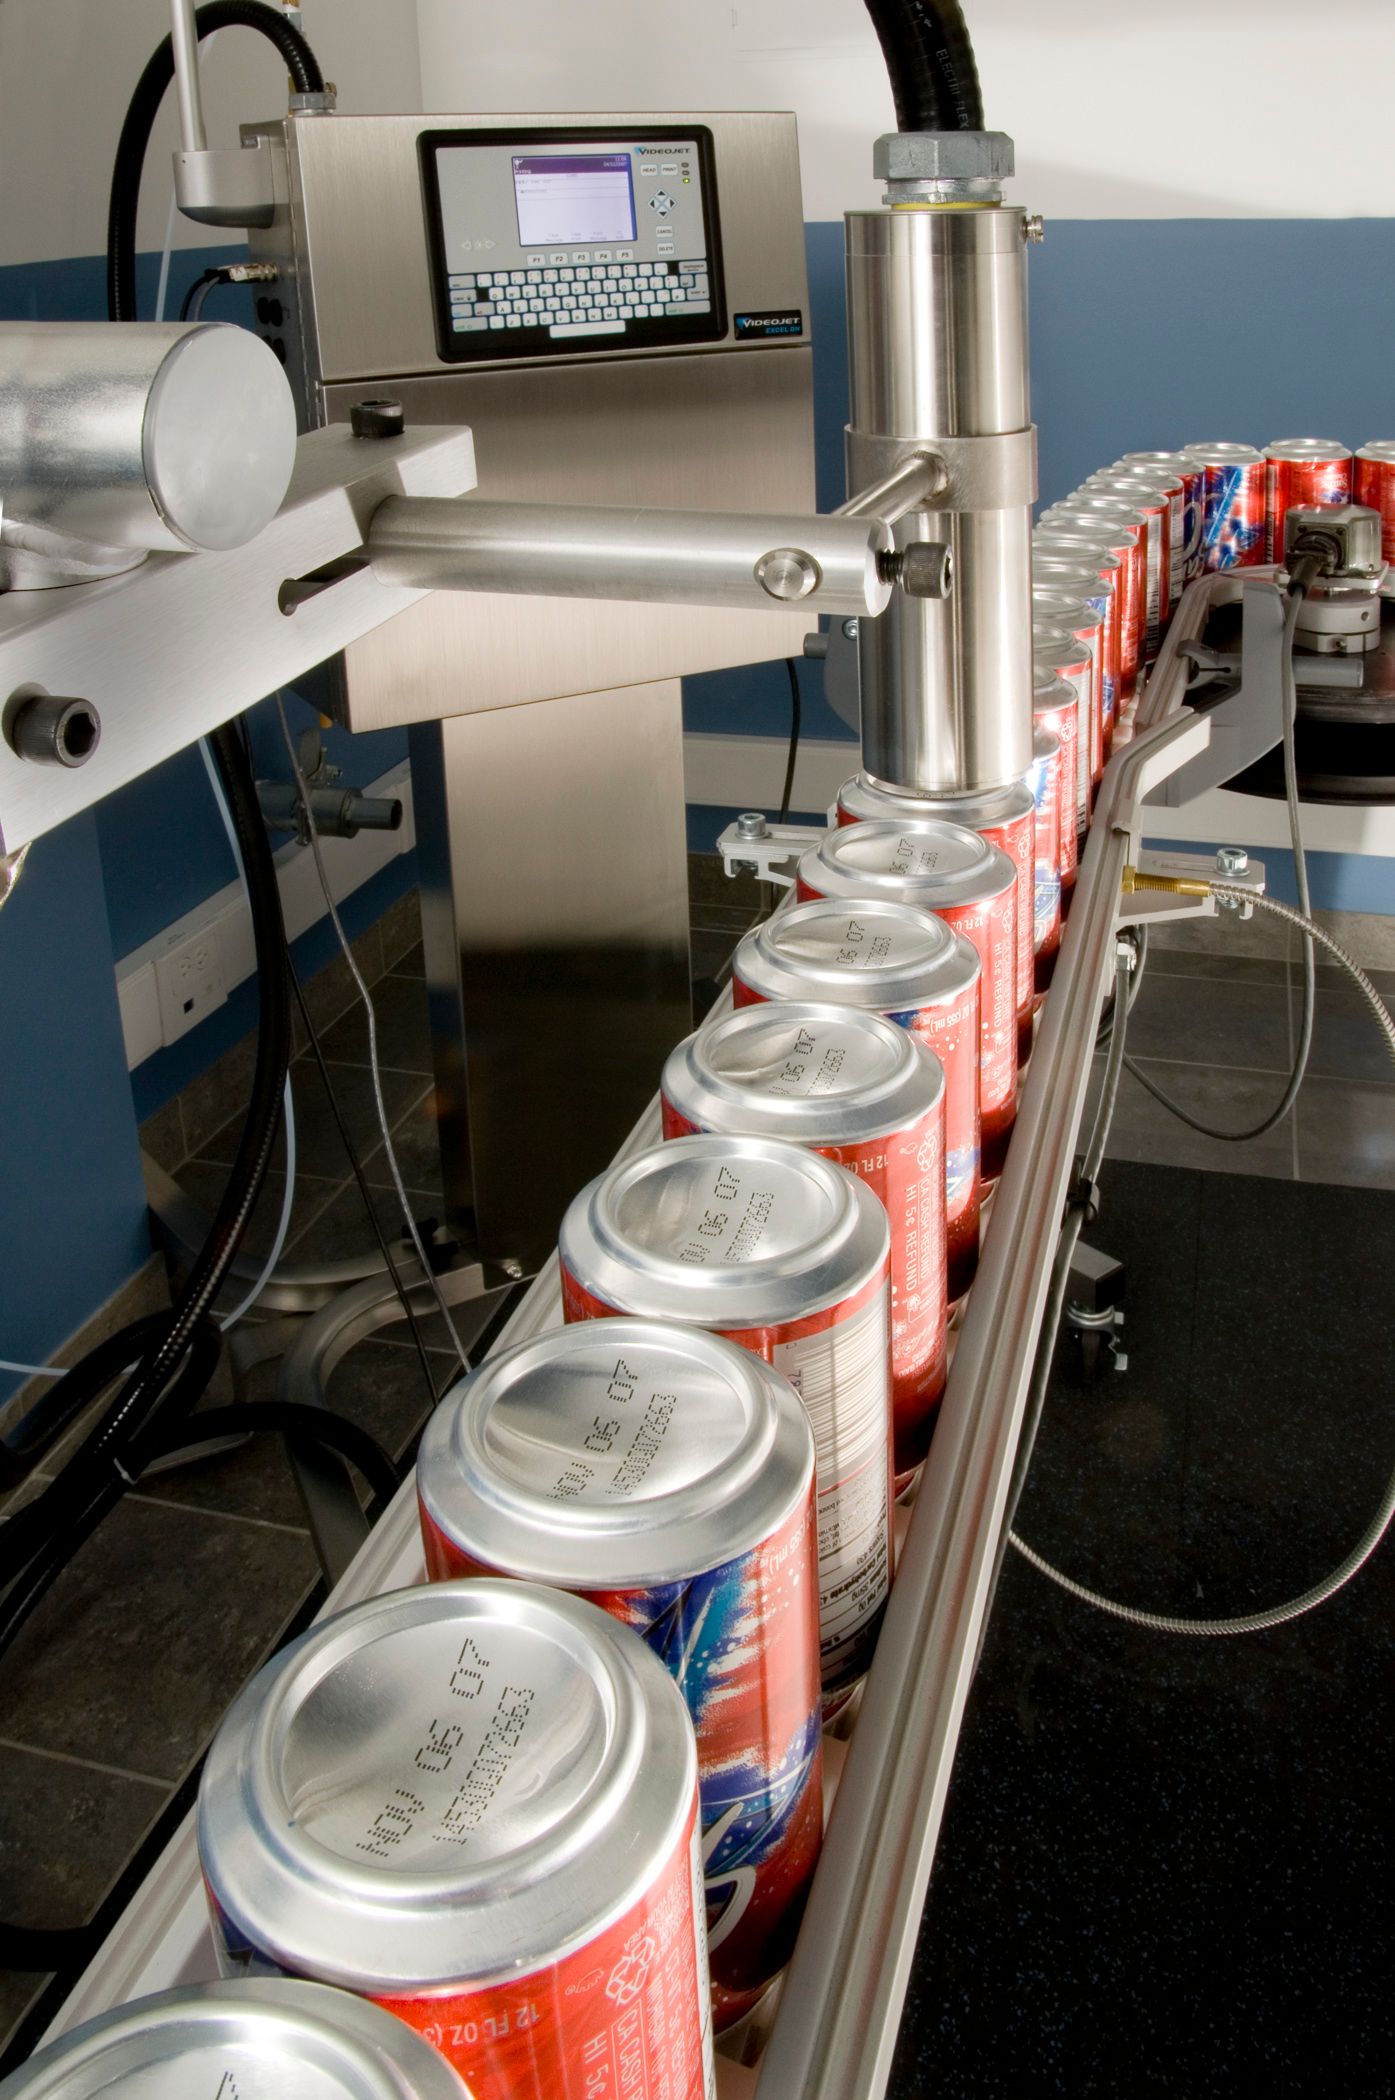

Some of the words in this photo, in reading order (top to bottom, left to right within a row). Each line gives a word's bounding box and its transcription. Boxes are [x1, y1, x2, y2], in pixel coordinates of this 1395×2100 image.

[742, 317, 801, 329] VIDEOJET
[846, 920, 865, 943] 07
[994, 979, 1002, 1028] REFUND
[793, 1028, 816, 1055] 07
[780, 1061, 805, 1083] 06
[861, 1158, 874, 1173] FL
[876, 1153, 889, 1169] 12
[714, 1166, 741, 1200] 07
[905, 1183, 917, 1203] HI
[698, 1209, 729, 1237] 06
[679, 1242, 711, 1264] OV
[905, 1233, 918, 1291] REFUND
[607, 1359, 639, 1403] 07
[584, 1415, 621, 1453] 06
[450, 1638, 490, 1699] 07
[414, 1719, 464, 1773] 06
[355, 1788, 425, 1857] NOV
[484, 2014, 510, 2038] FL
[514, 2002, 542, 2030] 12
[617, 2008, 639, 2046] CA
[450, 2022, 479, 2047] OZ
[583, 2030, 608, 2065] HI
[619, 2036, 642, 2095] CASH
